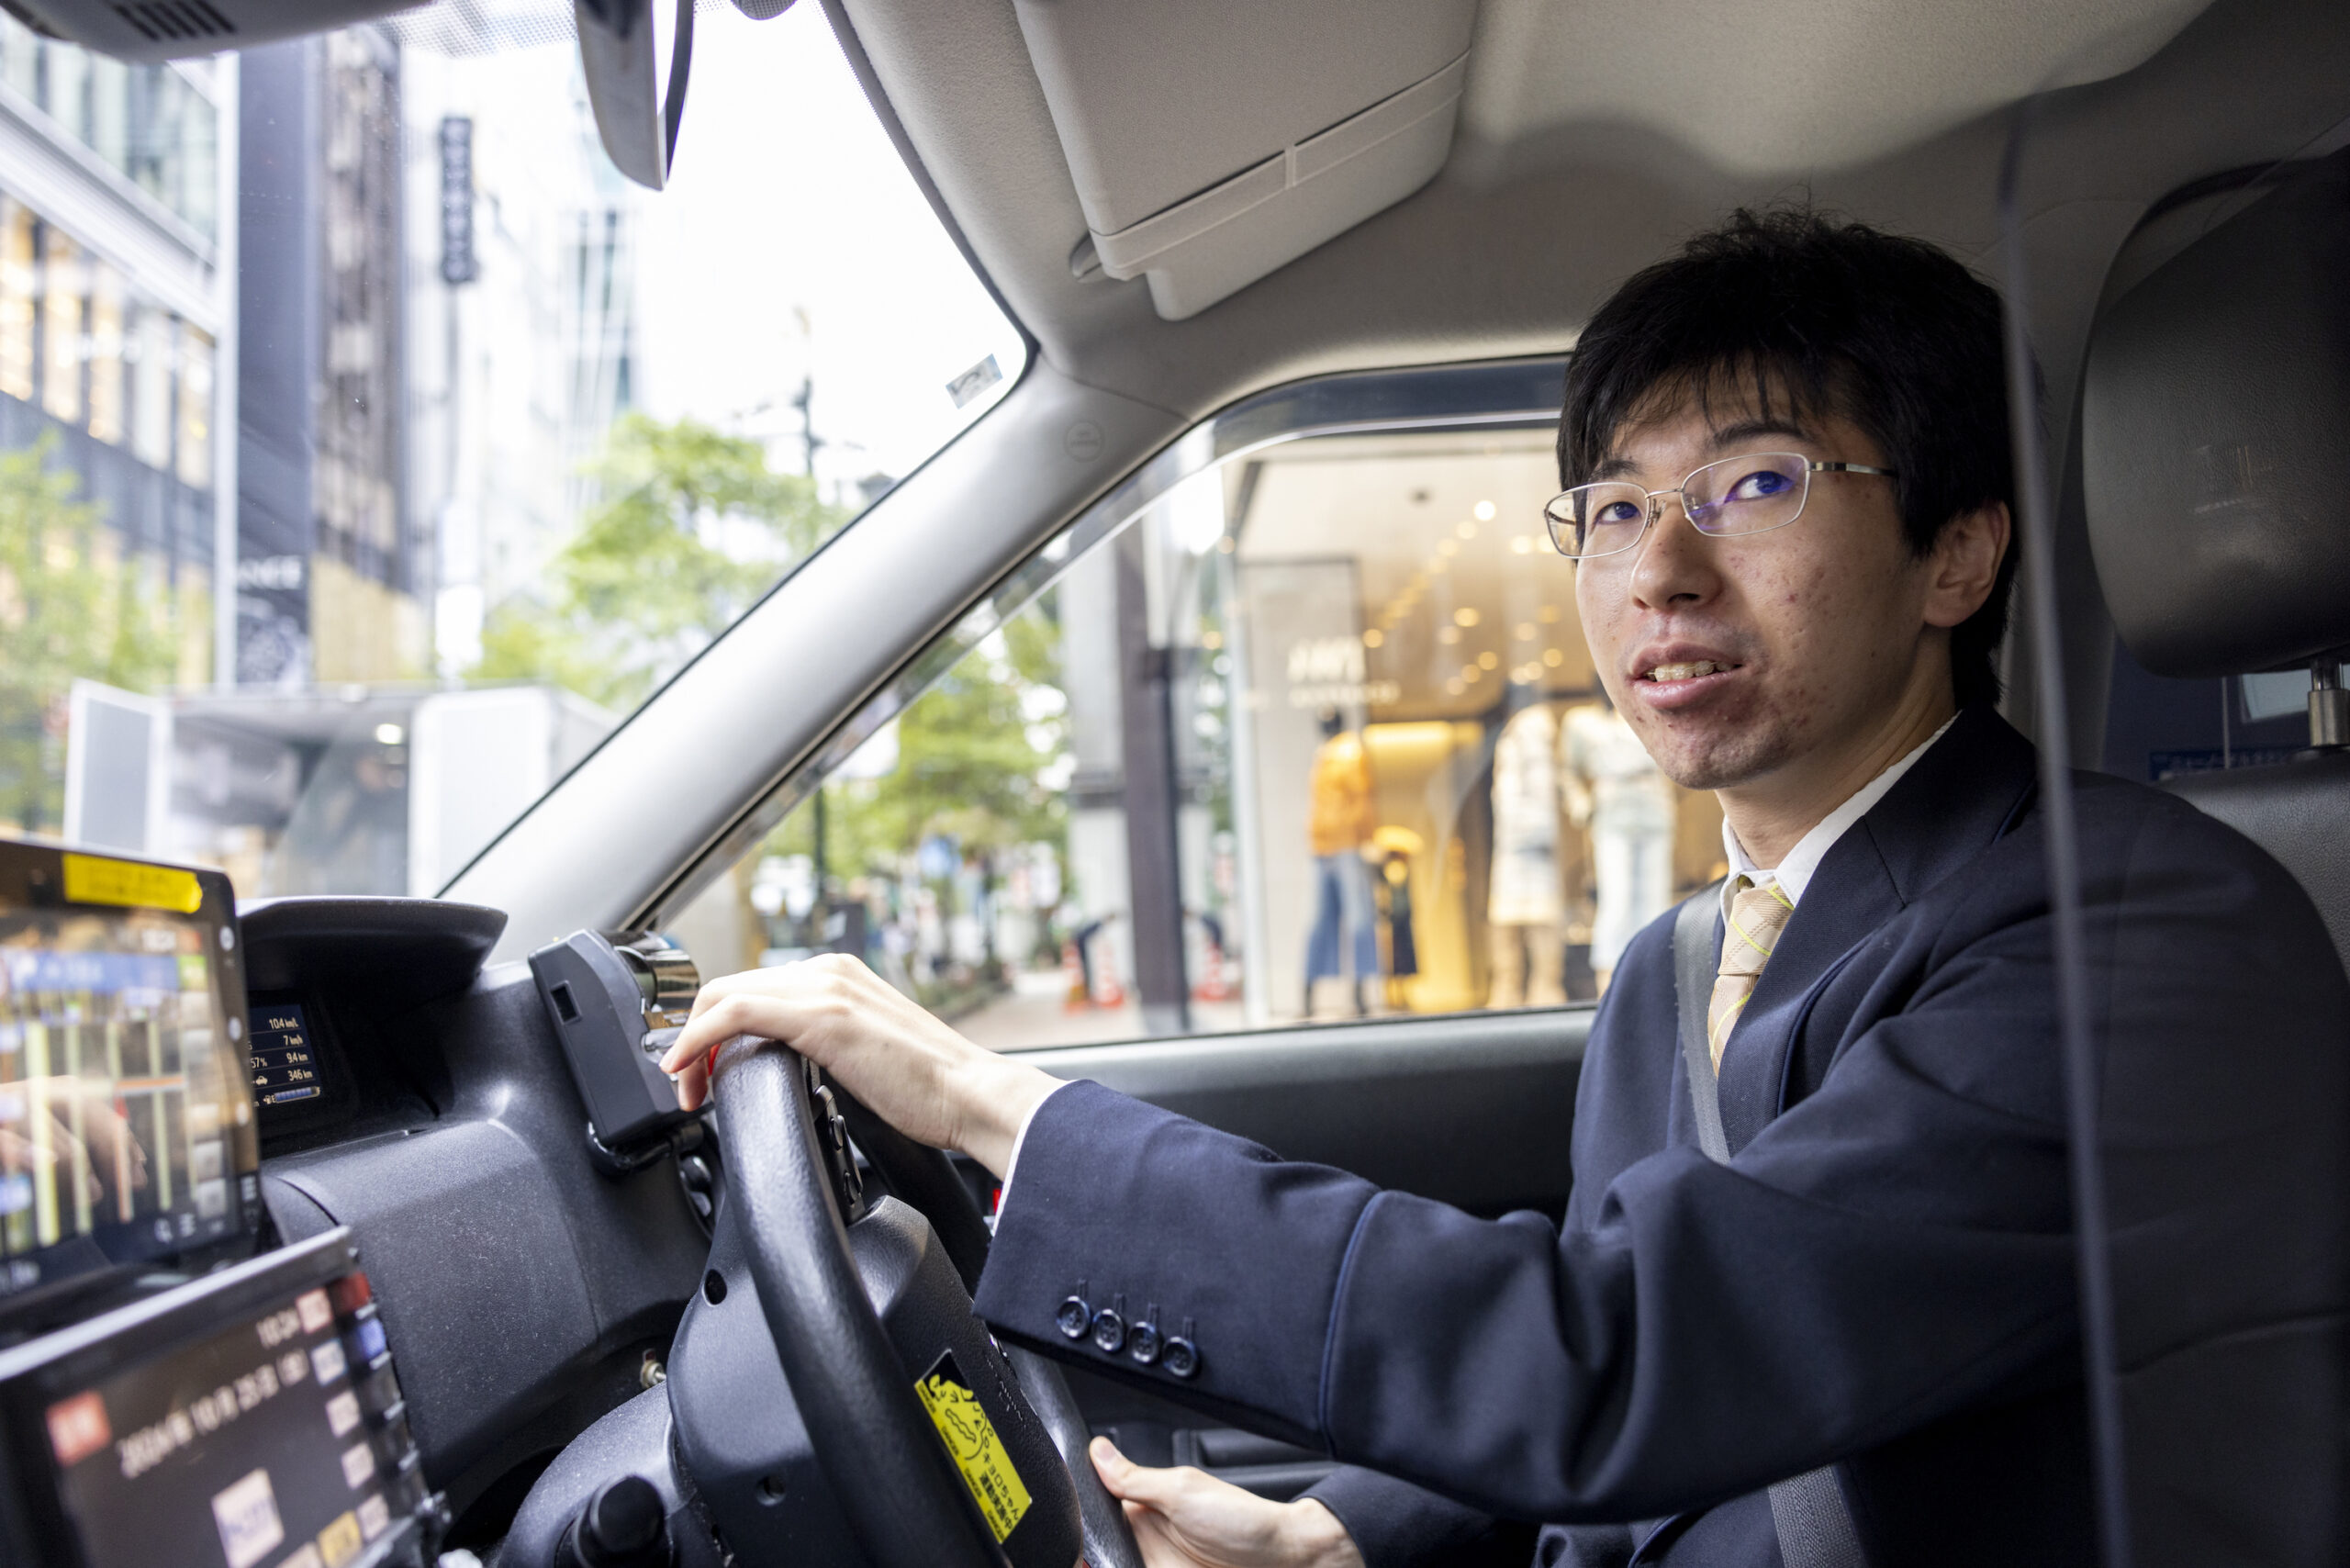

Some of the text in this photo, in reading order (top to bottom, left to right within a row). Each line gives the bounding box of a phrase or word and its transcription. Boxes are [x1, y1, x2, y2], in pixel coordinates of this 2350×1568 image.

[283, 1035, 289, 1046] 7
[983, 1452, 1020, 1520] キョロちゃん
